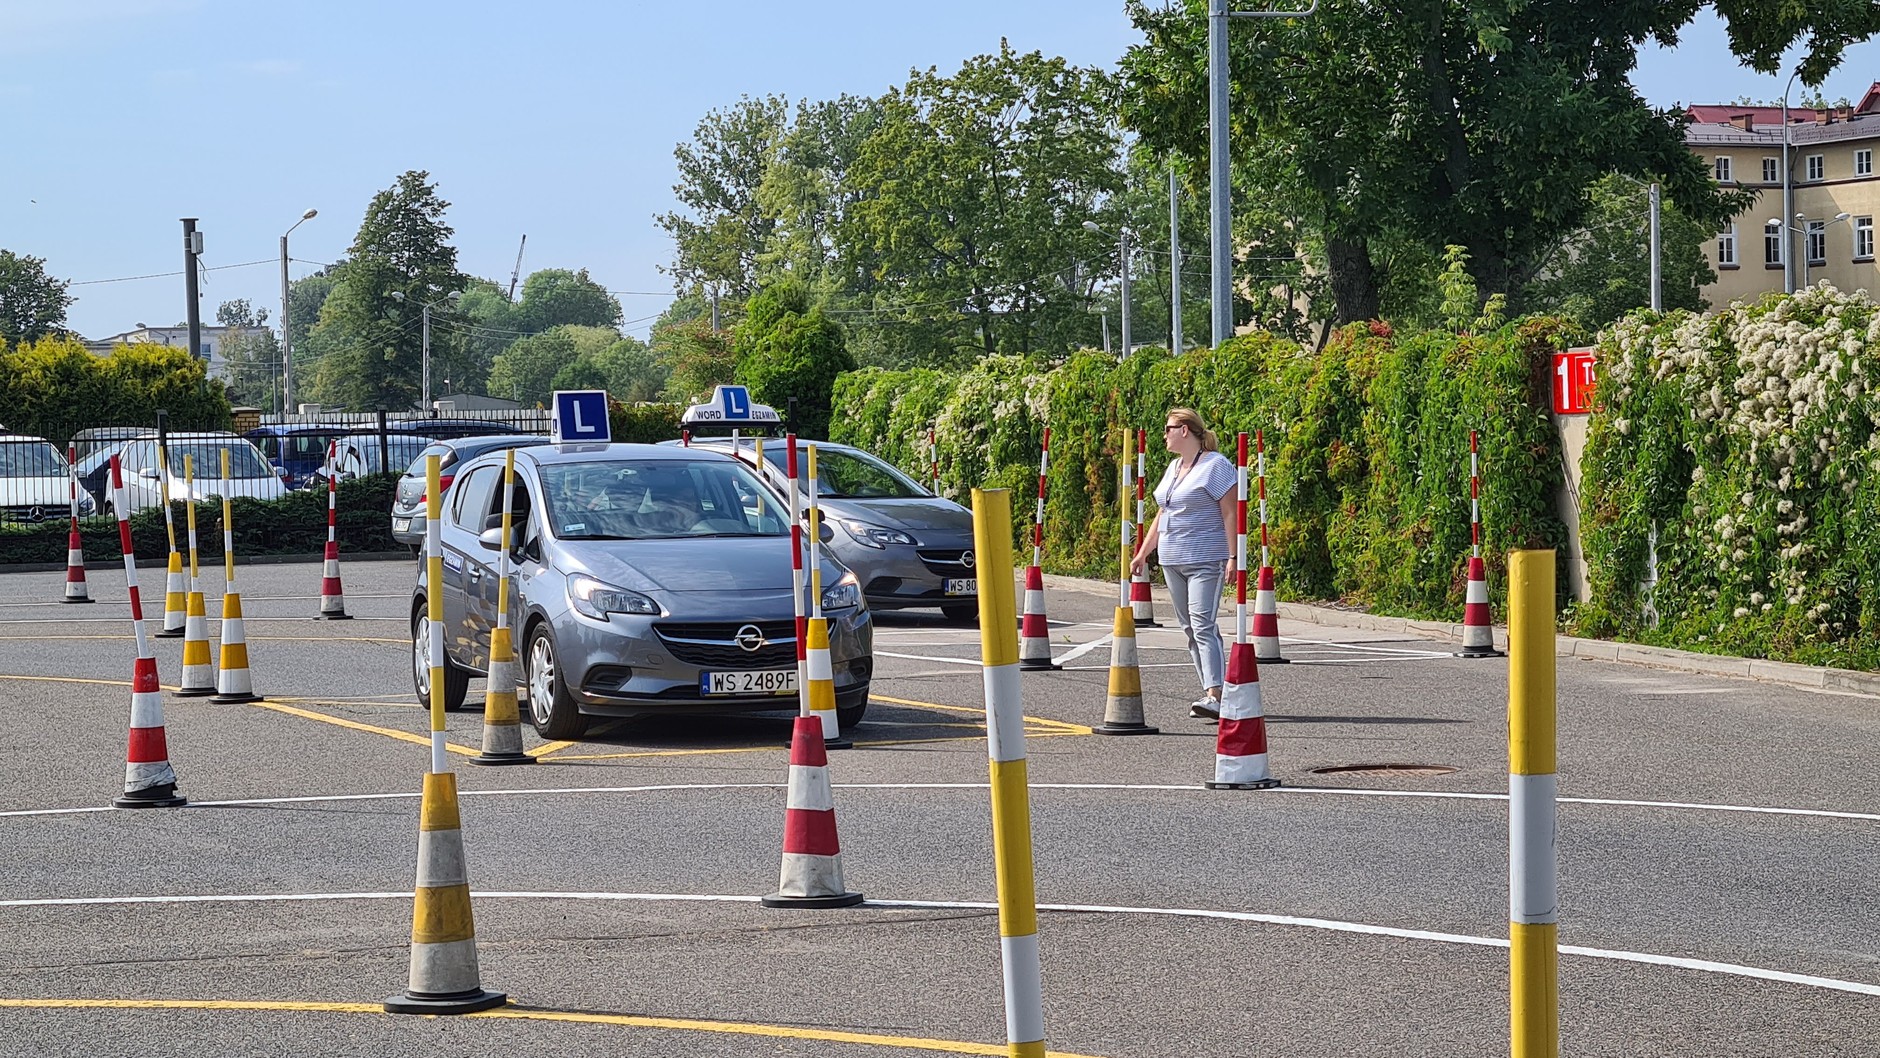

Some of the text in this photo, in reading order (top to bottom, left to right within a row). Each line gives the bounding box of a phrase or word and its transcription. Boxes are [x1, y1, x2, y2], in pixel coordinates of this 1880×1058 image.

[1557, 357, 1570, 410] 1
[730, 391, 744, 413] L
[573, 400, 595, 432] L
[696, 410, 776, 420] WORD EGZAMIN
[950, 580, 963, 591] WS
[714, 672, 796, 691] WS 2489F
